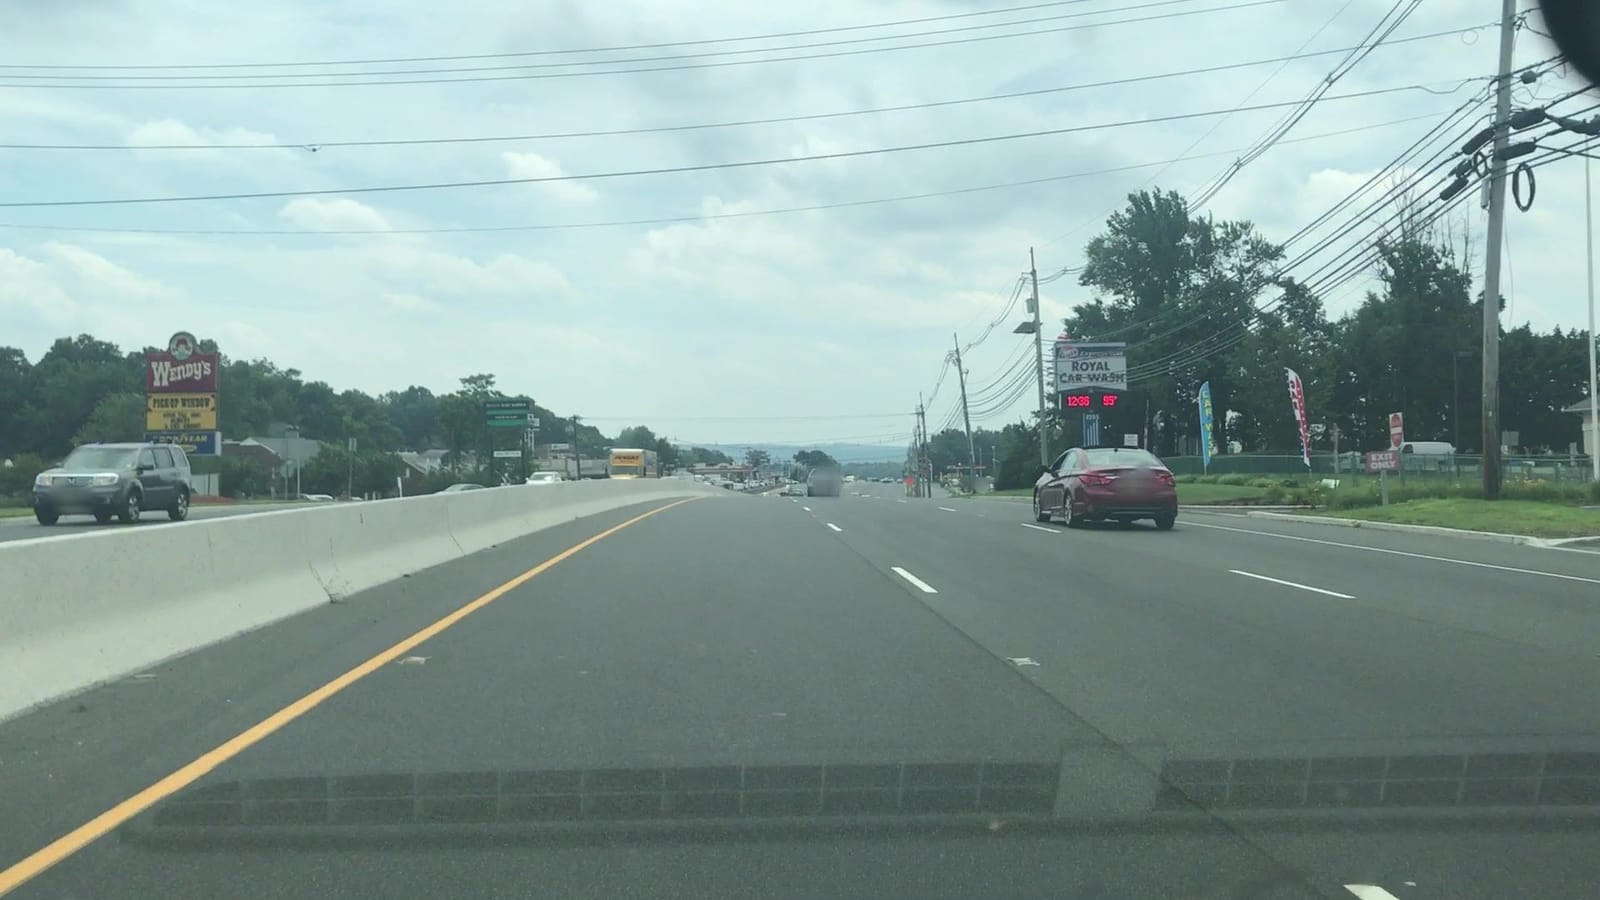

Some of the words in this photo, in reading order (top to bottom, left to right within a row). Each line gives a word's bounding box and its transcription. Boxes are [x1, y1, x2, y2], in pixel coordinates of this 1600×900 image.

[1072, 361, 1110, 371] ROYAL
[1060, 372, 1082, 383] CAR
[181, 398, 210, 408] WINDOW
[1371, 453, 1393, 461] EXIT
[1371, 461, 1396, 469] ONLY
